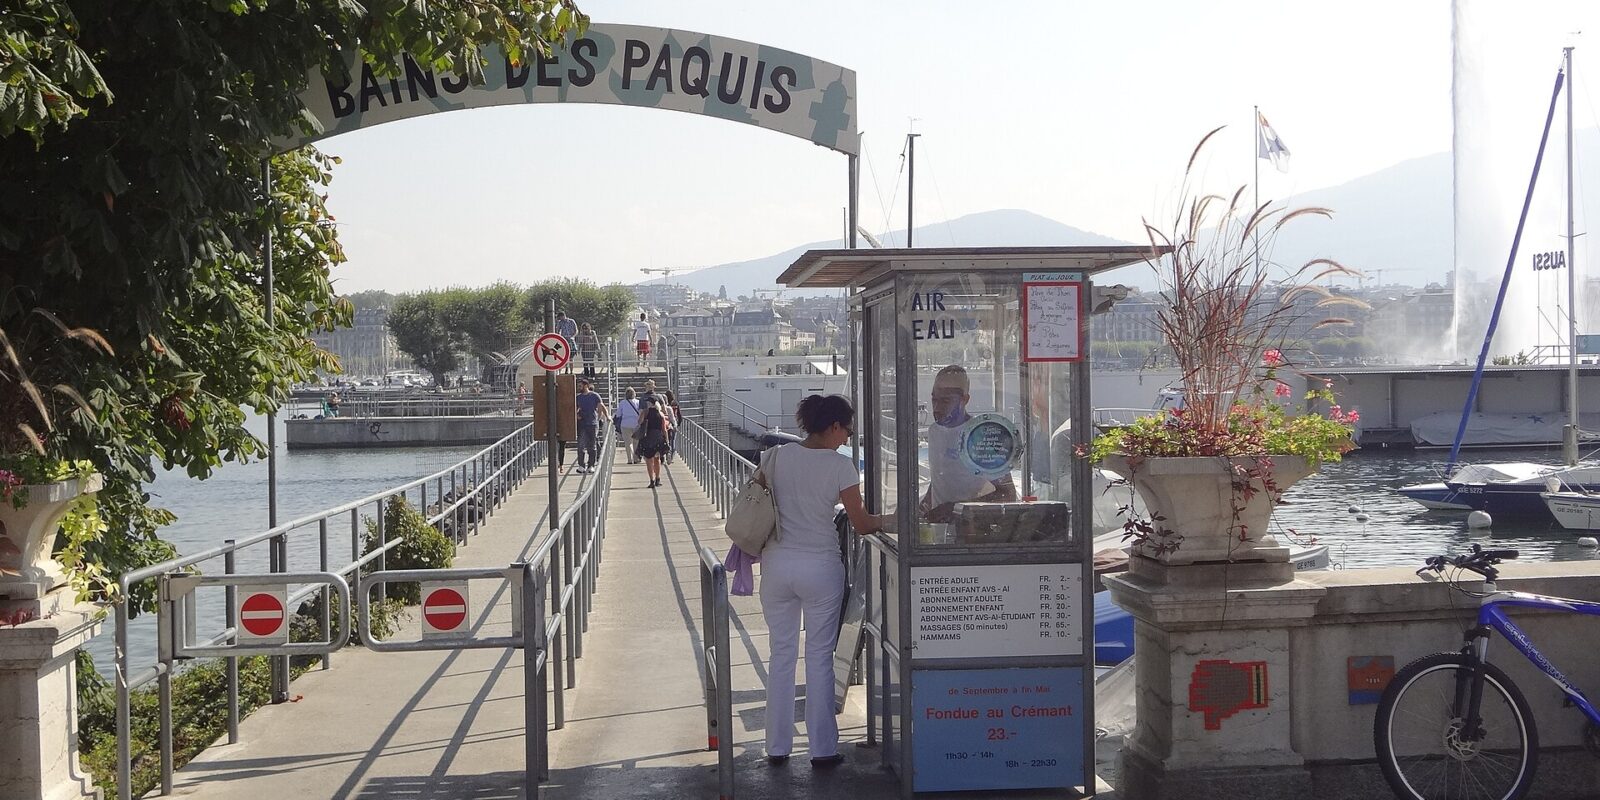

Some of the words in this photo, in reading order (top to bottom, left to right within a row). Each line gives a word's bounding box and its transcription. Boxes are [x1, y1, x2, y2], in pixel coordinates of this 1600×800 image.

[504, 38, 598, 89] DES
[621, 39, 797, 114] PAQUIS
[911, 292, 945, 312] AIR
[912, 319, 955, 340] EAU
[921, 614, 974, 622] ABONNEMENT
[975, 612, 1035, 621] AVS-AI-ÉTUDIANT
[976, 622, 1008, 630] minutes)
[963, 687, 1008, 695] Septembre
[926, 708, 979, 719] Fondue
[987, 709, 1003, 718] au
[1011, 705, 1072, 717] Crémant
[988, 728, 1017, 740] 23.-
[946, 752, 968, 760] 11h30
[1031, 759, 1056, 767] 22h30
